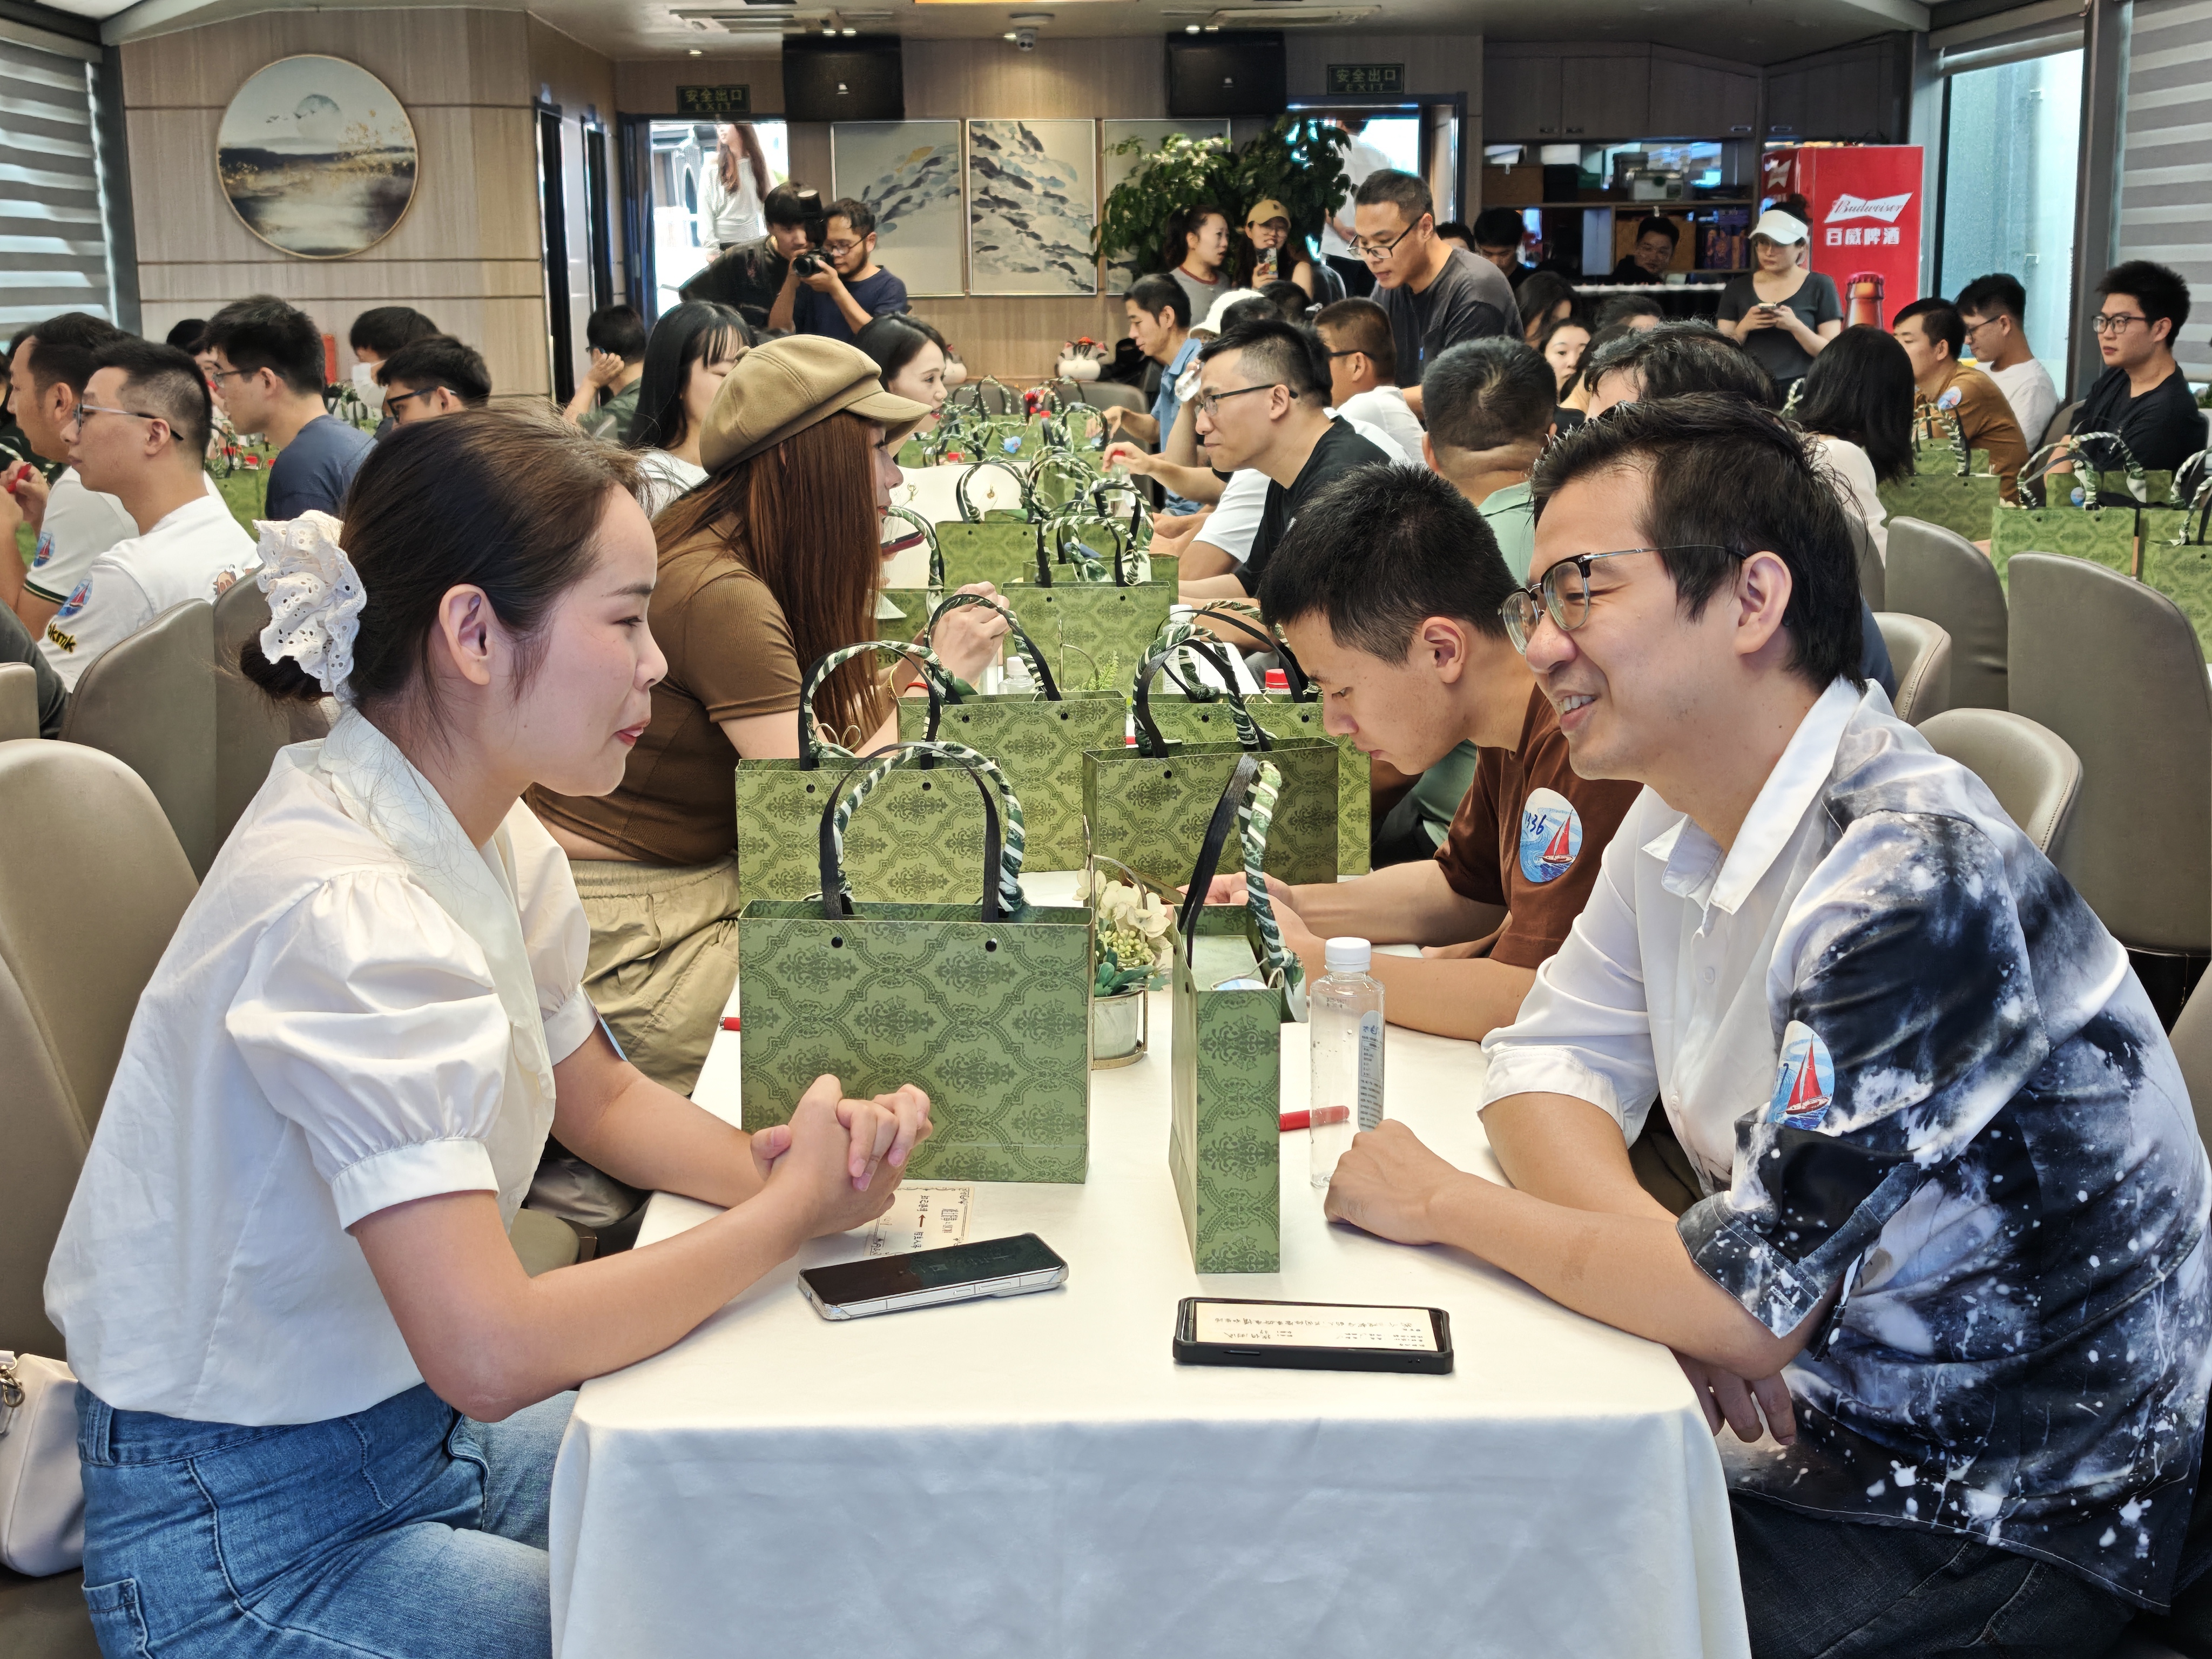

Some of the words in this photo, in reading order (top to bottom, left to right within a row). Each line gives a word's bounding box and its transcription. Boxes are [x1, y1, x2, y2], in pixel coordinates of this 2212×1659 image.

[1336, 68, 1394, 83] 安全出口
[685, 87, 743, 102] 安全出口
[1345, 83, 1382, 91] EXIT
[1832, 200, 1904, 214] Budweiser
[1826, 227, 1900, 246] 百威啤酒
